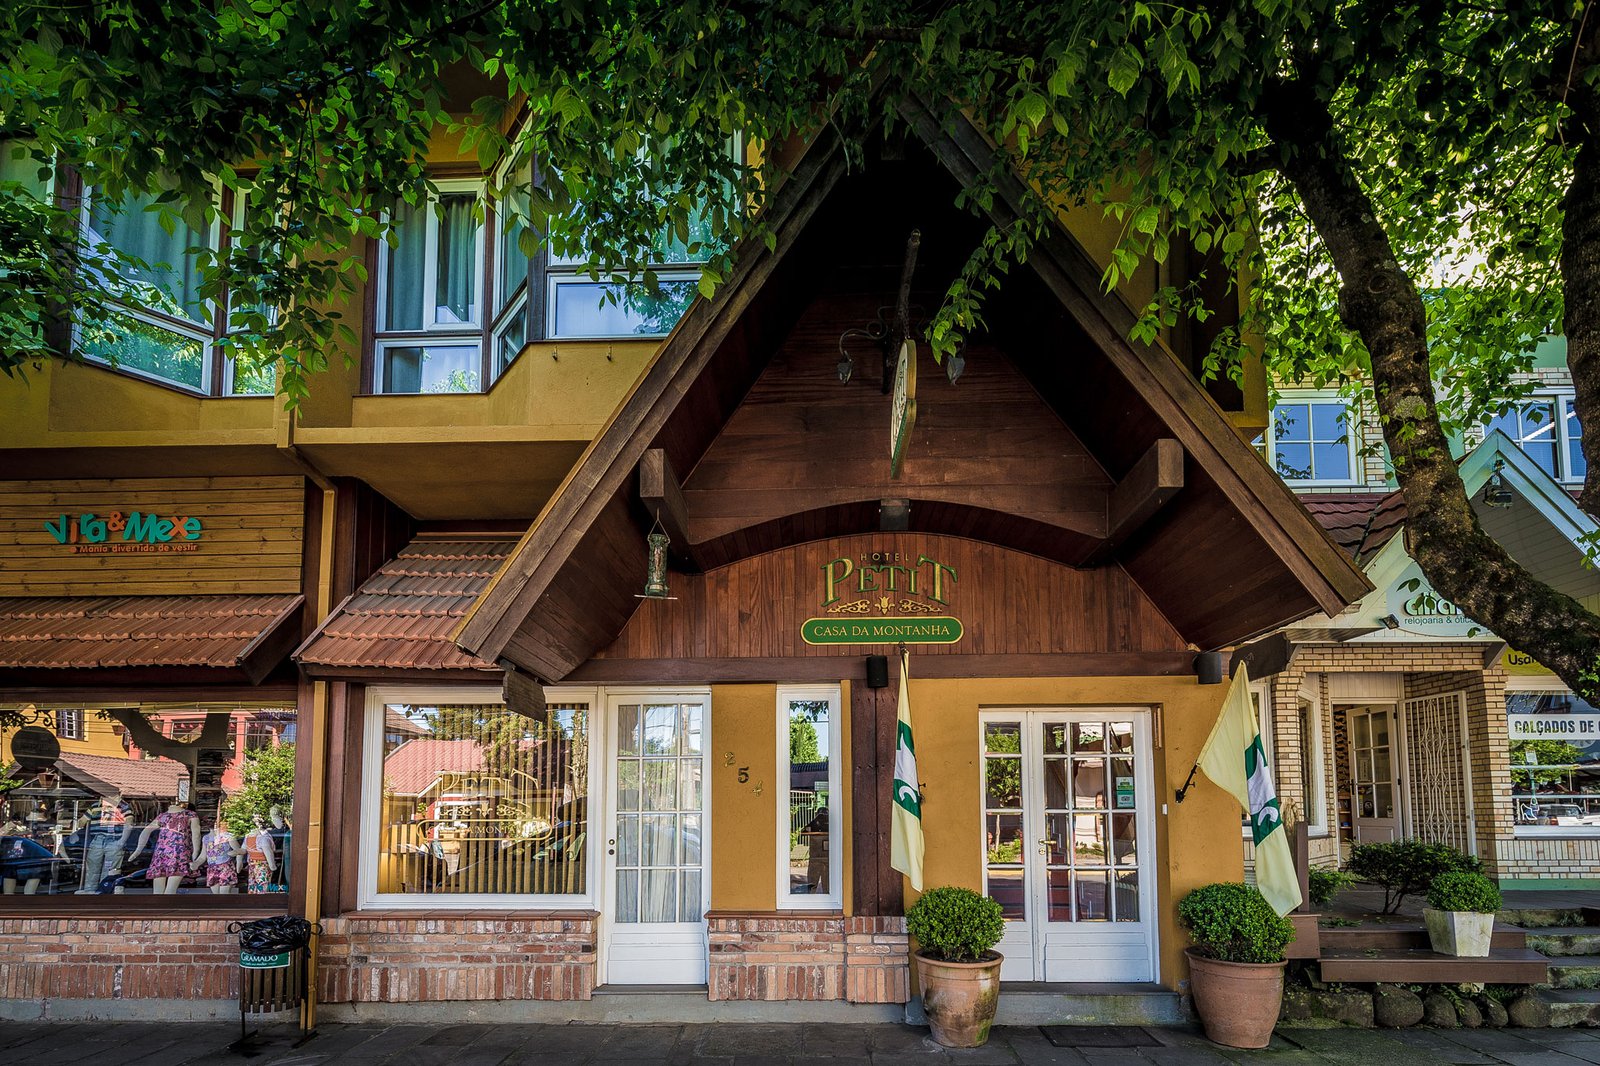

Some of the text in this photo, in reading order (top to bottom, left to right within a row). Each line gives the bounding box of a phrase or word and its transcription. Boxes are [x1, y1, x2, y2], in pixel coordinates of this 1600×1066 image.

[79, 542, 199, 553] Mania divertida de vestir
[860, 552, 909, 562] HOTEL
[820, 553, 959, 607] PETIT
[1404, 616, 1444, 626] relojoaria
[813, 624, 951, 636] CASA DA MONTANHA
[1514, 720, 1576, 736] CALÇADOS
[1580, 720, 1595, 734] DE
[436, 768, 539, 809] PETIT
